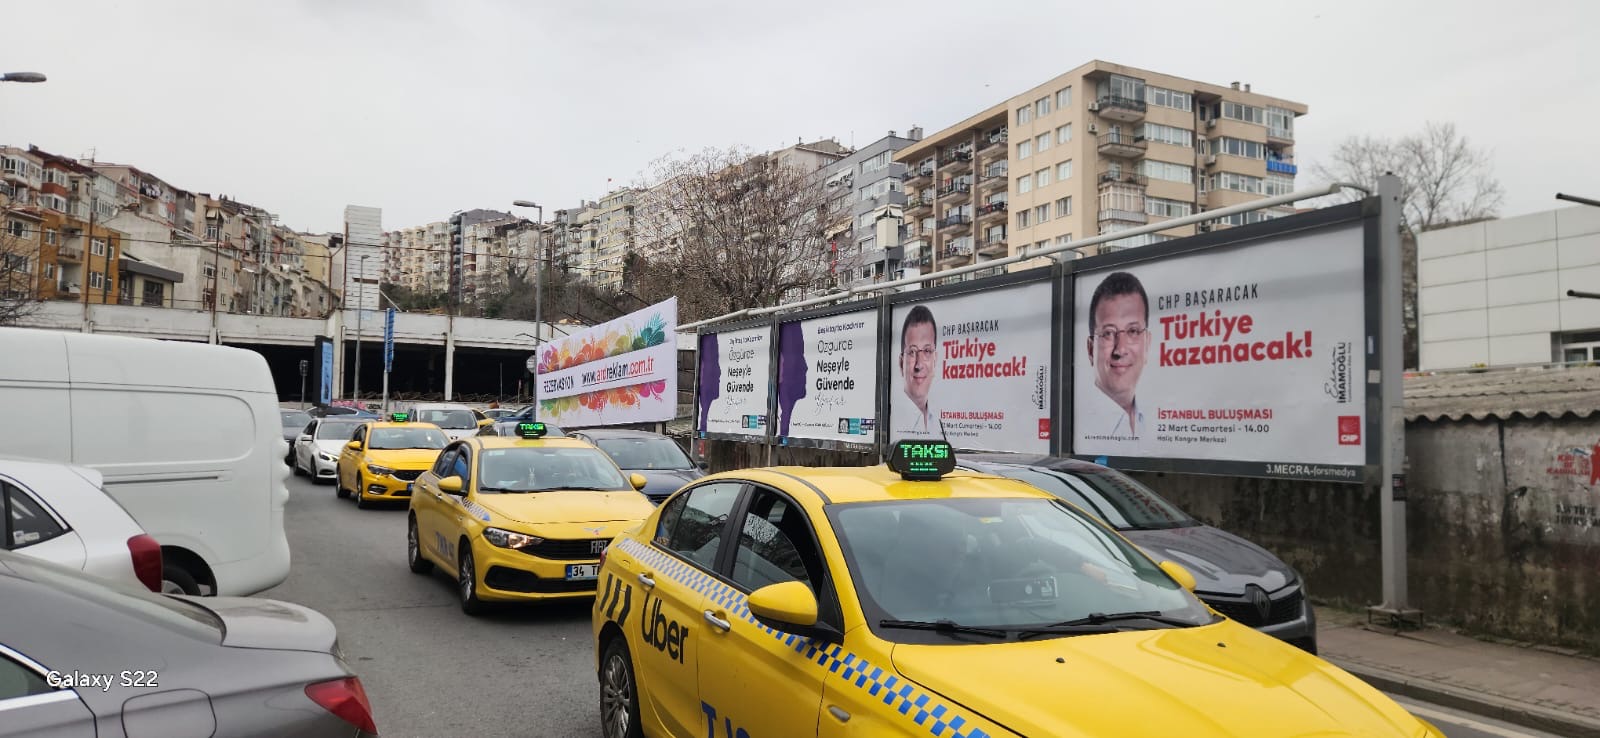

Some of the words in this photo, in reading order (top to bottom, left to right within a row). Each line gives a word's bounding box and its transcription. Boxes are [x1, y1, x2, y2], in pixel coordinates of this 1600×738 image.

[1158, 295, 1180, 311] CHP
[1186, 283, 1258, 308] BAŞARACAK
[943, 325, 956, 336] CHP
[958, 319, 999, 336] BAŞARACAK
[1159, 309, 1253, 342] Türkiye
[943, 337, 996, 362] Türkiye
[1159, 330, 1312, 367] kazanacak!
[816, 357, 850, 374] Neşeyle
[942, 356, 1027, 380] kazanacak!
[726, 380, 754, 393] Güvende
[816, 377, 855, 391] Güvende
[941, 409, 968, 420] İSTANBUL
[969, 412, 1004, 421] BULUŞMASI
[1157, 408, 1206, 420] İSTANBUL
[1208, 409, 1273, 422] BULUŞMASI
[1157, 424, 1166, 432] 22
[1168, 424, 1188, 432] Mart
[1190, 424, 1236, 433] Cumartesi
[1244, 425, 1270, 433] 14.00
[573, 566, 584, 577] 34
[641, 594, 689, 665] Uber
